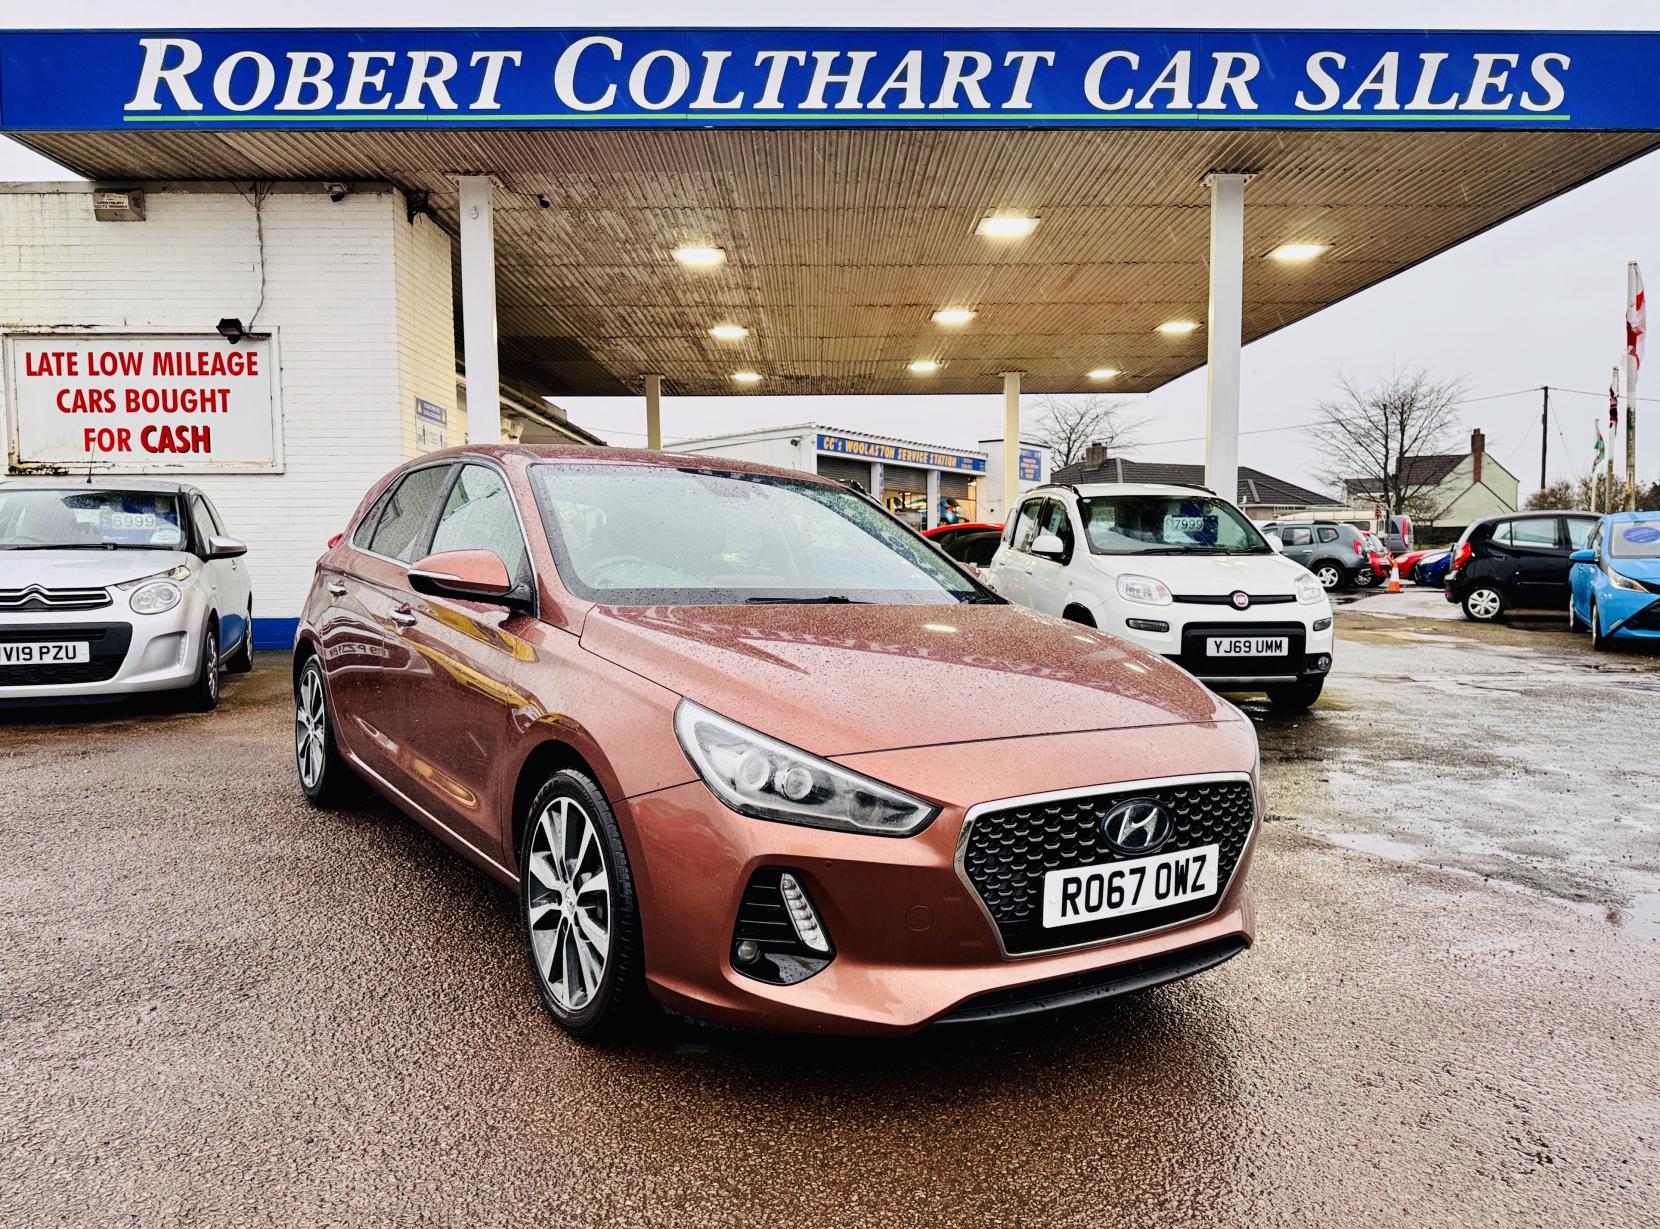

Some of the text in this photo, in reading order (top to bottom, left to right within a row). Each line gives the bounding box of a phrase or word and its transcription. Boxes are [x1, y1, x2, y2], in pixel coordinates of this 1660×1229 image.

[124, 37, 1571, 112] ROBERT COLTHART CAR SALES
[25, 351, 259, 377] LATE LOW MILEAGE
[56, 388, 231, 414] CARS BOUGHT
[84, 425, 211, 453] FOR CASH
[845, 440, 896, 459] WOOLASTON
[897, 447, 928, 464] SERVICE
[929, 452, 957, 469] STATION
[0, 644, 77, 662] V19 PZU
[1214, 639, 1283, 654] YJ69 UMM
[1060, 854, 1207, 918] RO67 OWZ
